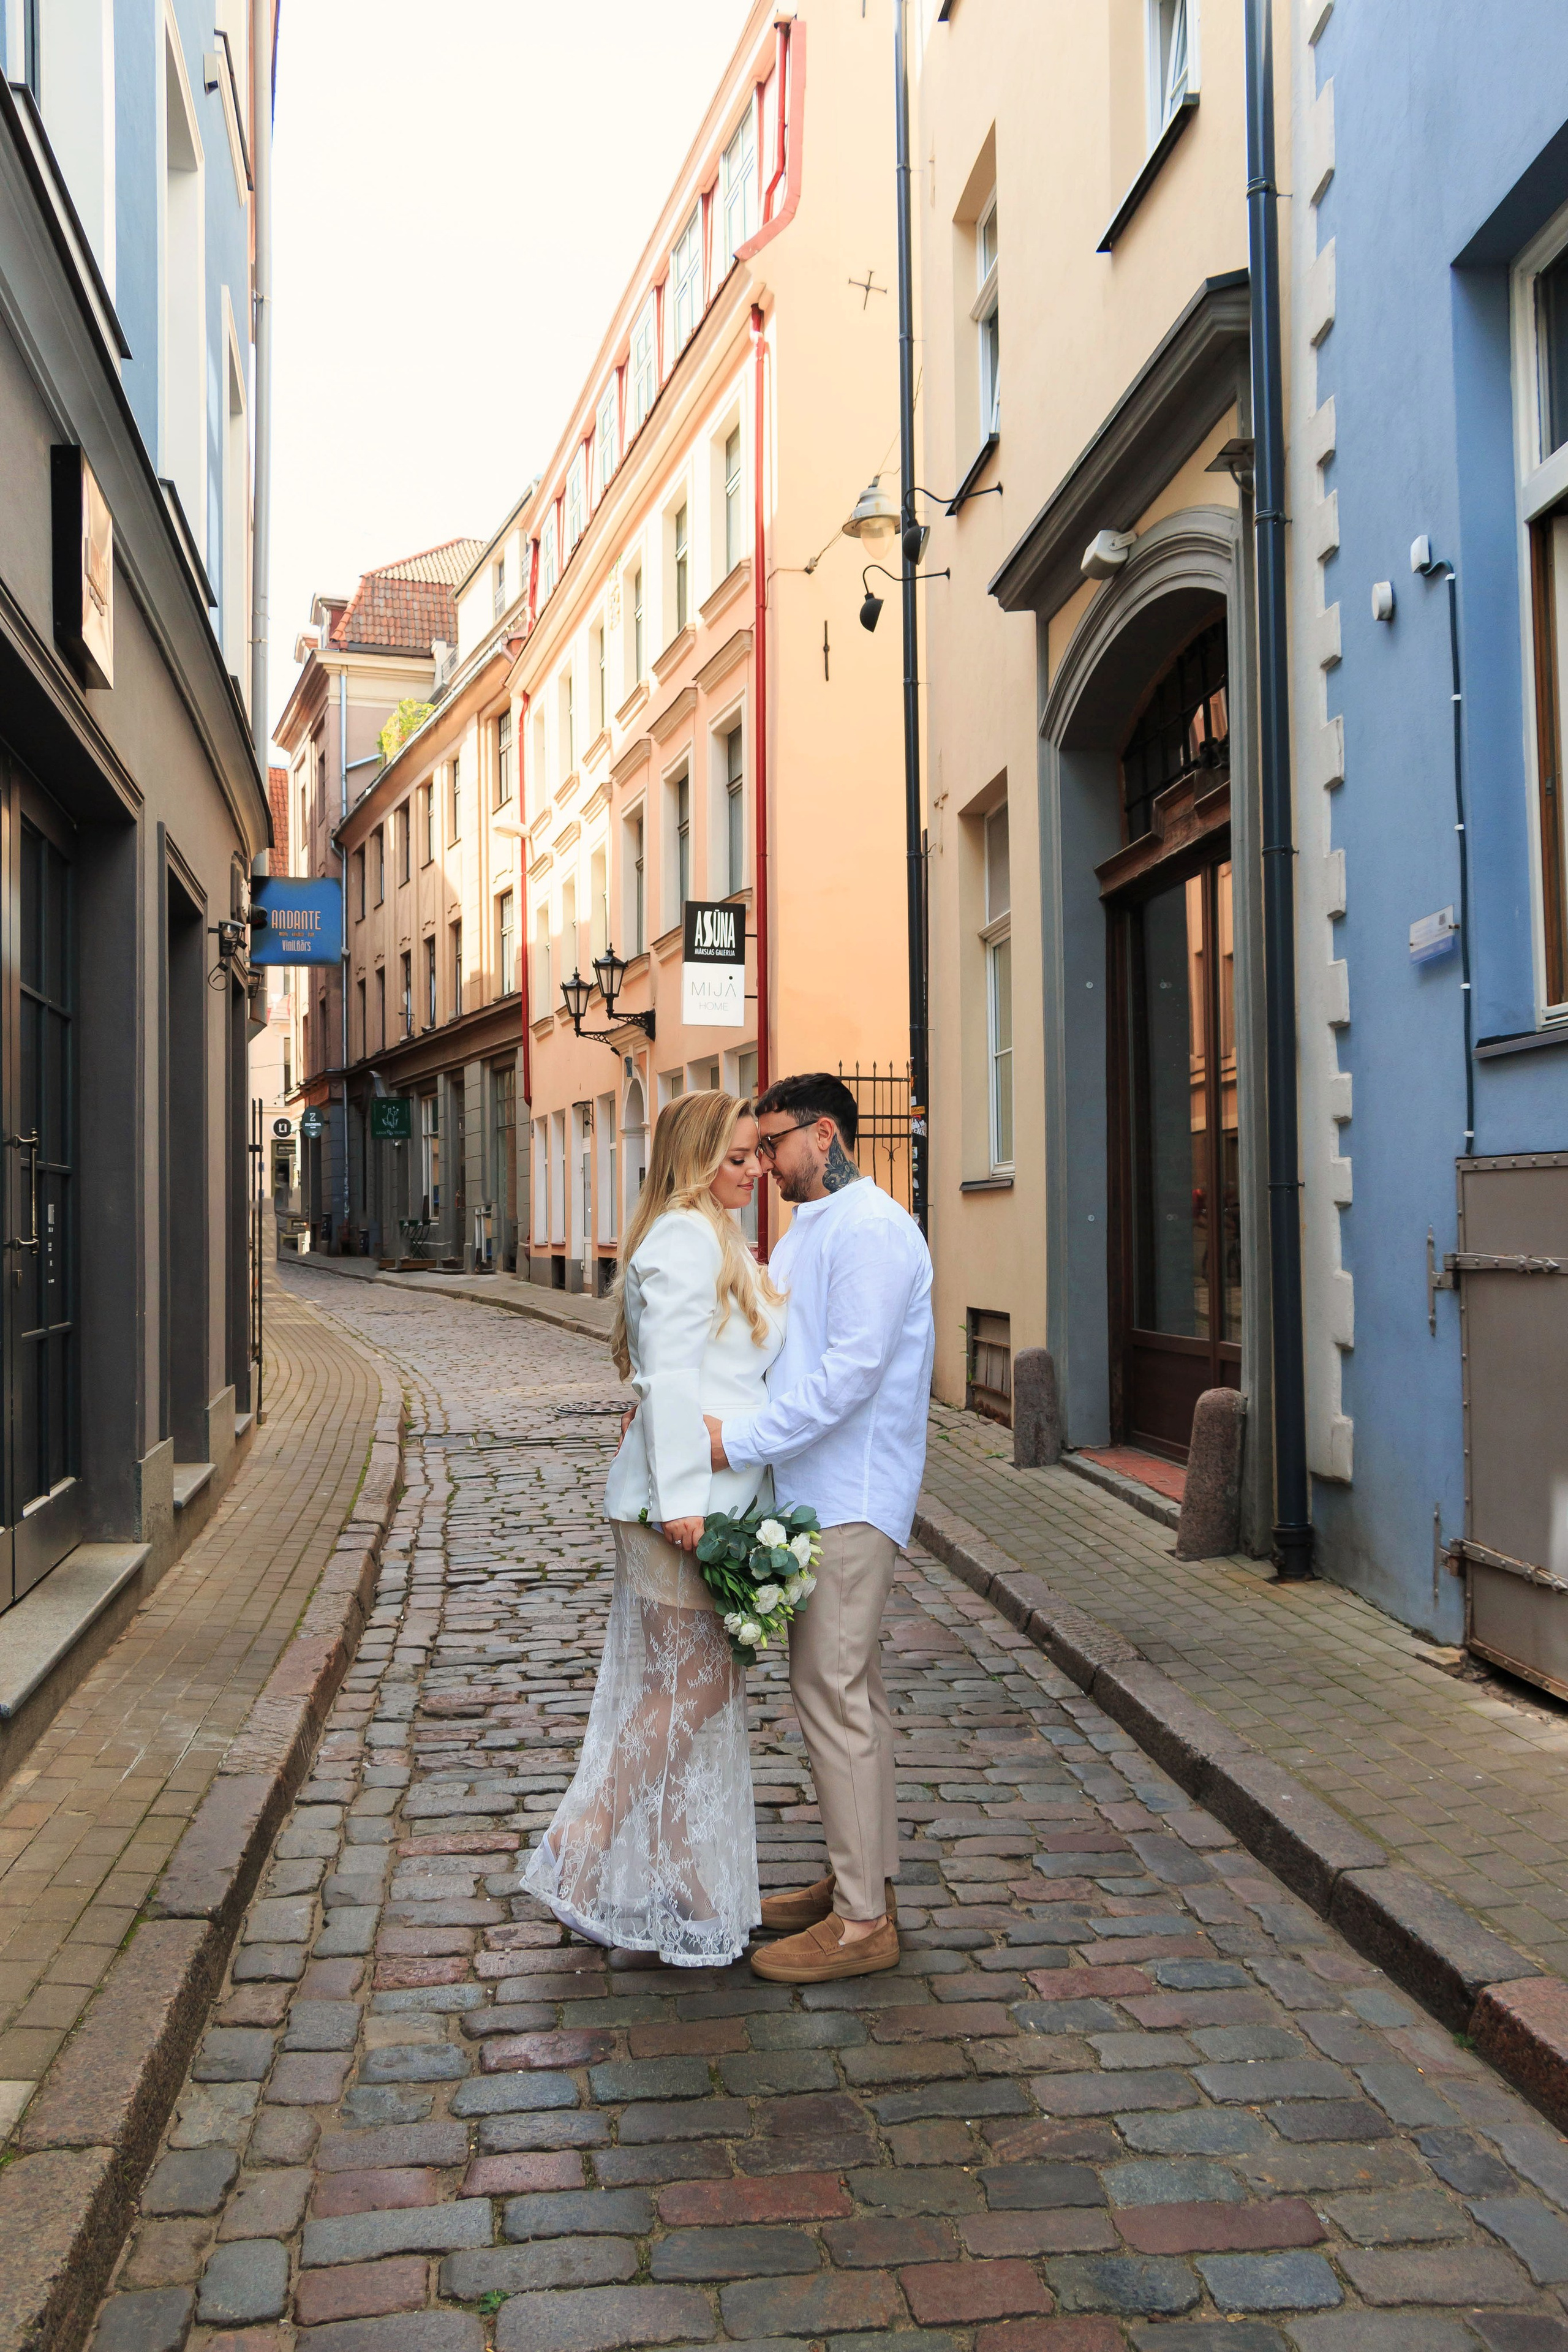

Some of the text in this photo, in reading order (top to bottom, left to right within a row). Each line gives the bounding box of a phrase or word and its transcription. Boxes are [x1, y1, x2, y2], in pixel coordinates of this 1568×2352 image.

[271, 910, 322, 930] ANDANTE
[695, 909, 735, 948] ASŪNA
[699, 1001, 729, 1011] HOME
